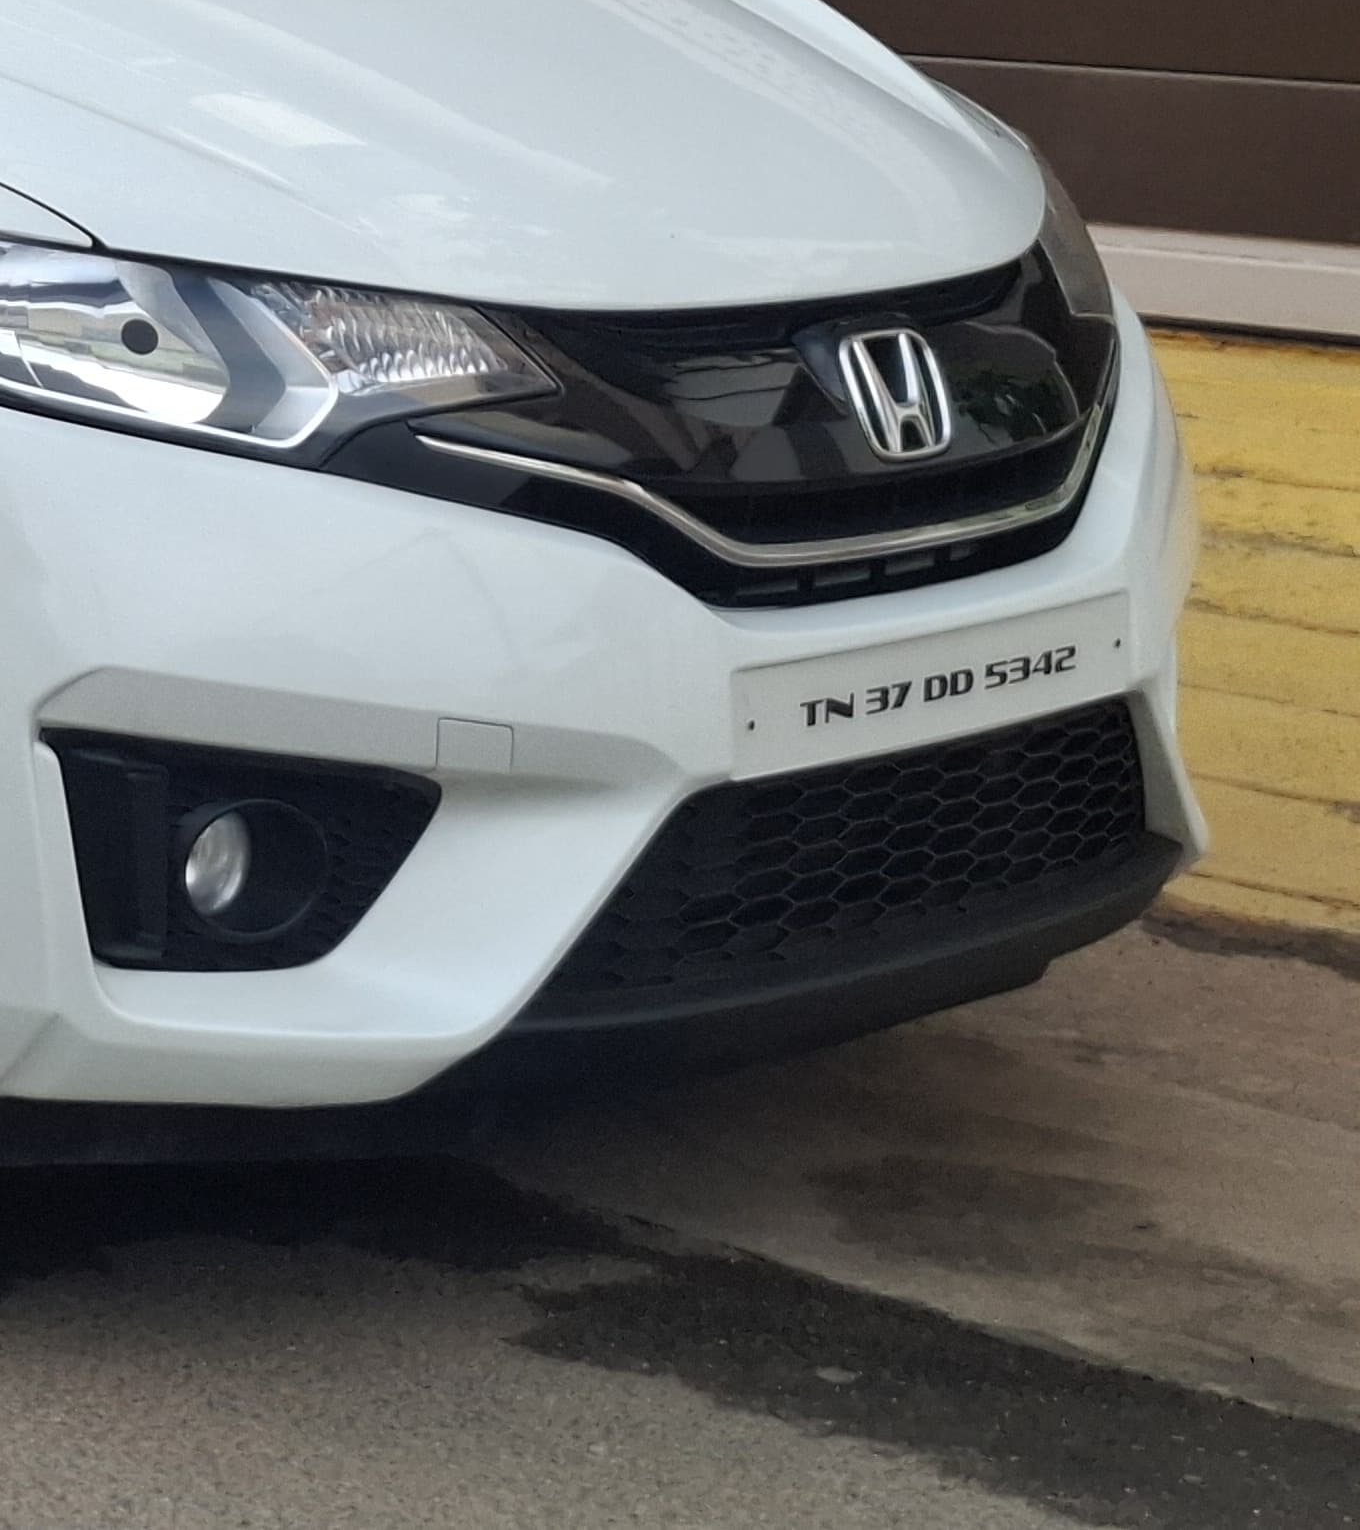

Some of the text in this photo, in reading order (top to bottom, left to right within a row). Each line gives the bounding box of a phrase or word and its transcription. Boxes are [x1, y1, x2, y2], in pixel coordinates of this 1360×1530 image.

[799, 645, 1077, 727] TN 37 DD 5342
